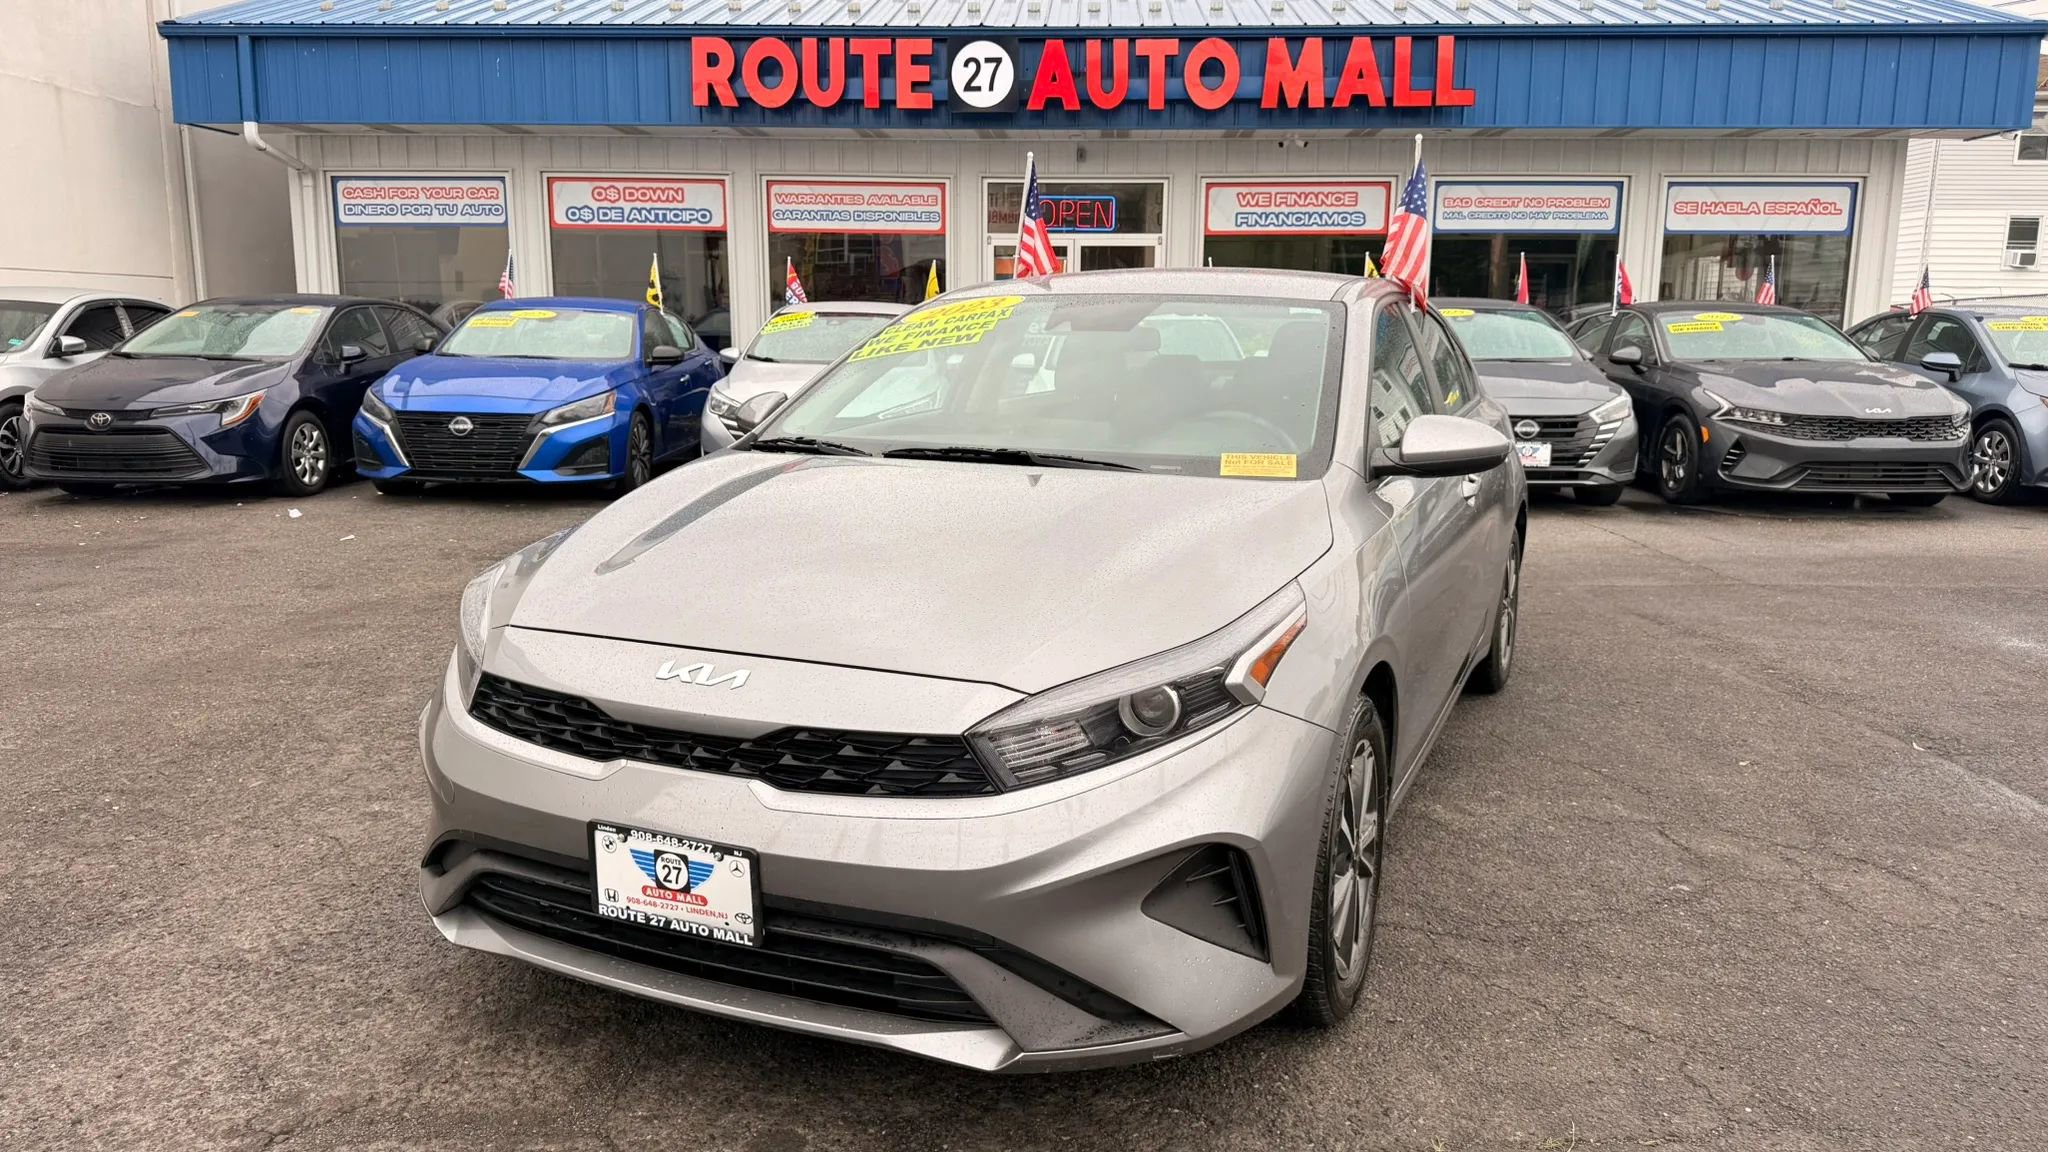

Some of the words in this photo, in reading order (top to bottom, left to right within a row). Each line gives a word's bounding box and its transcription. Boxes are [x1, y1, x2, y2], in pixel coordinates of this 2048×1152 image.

[691, 37, 933, 109] ROUTE
[963, 57, 1003, 92] 27
[1026, 37, 1240, 111] AUTO
[1260, 35, 1475, 109] MALL
[343, 187, 386, 199] CASH
[388, 187, 419, 199] FOR
[421, 187, 464, 200] YOUR
[466, 187, 499, 200] CAR
[623, 187, 684, 202] DOWN
[775, 193, 864, 205] WARRANTIES
[867, 194, 938, 206] AVAILABLE
[1237, 192, 1272, 207] WE
[1274, 192, 1358, 207] FINANCE
[344, 204, 398, 216] DINERO
[400, 204, 432, 216] POR
[434, 204, 458, 216] TU
[460, 204, 504, 216] AUTO
[1444, 197, 1473, 208] BAD
[1474, 197, 1522, 208] CREDIT
[1524, 197, 1545, 208] NO
[1547, 197, 1611, 208] PROBLEM
[1674, 201, 1698, 214] SE
[1700, 202, 1760, 215] HABLA
[1763, 198, 1842, 215] ESPAÑOL
[597, 207, 624, 221] DE
[627, 207, 712, 224] ANTICIPO
[773, 209, 851, 221] GARANTIAS
[853, 210, 940, 222] DISPONIBLES
[1040, 200, 1112, 227] OPEN
[1235, 212, 1366, 227] FINANCIAMOS
[1443, 211, 1466, 220] MAL
[1467, 211, 1510, 220] CREDITO
[1511, 211, 1528, 220] NO
[1529, 211, 1551, 220] HAY
[1552, 211, 1609, 220] PROBLEMA
[923, 298, 1003, 320] 2023
[884, 319, 939, 335] CLEAN
[943, 308, 1009, 325] CARFAX
[868, 335, 898, 348] WE
[903, 319, 994, 341] FINANCE
[853, 341, 913, 360] LIKE
[917, 332, 979, 349] NEW
[597, 824, 616, 832] Linden
[631, 830, 712, 854] 908-648-2727
[660, 857, 682, 866] ROUTE
[662, 864, 682, 885] 27
[626, 895, 679, 912] 908-648-2727
[645, 887, 673, 900] AUTO
[676, 892, 705, 905] MALL
[599, 904, 646, 924] ROUTE
[650, 914, 666, 927] 27
[670, 919, 709, 937] AUTO
[713, 928, 753, 946] MALL
